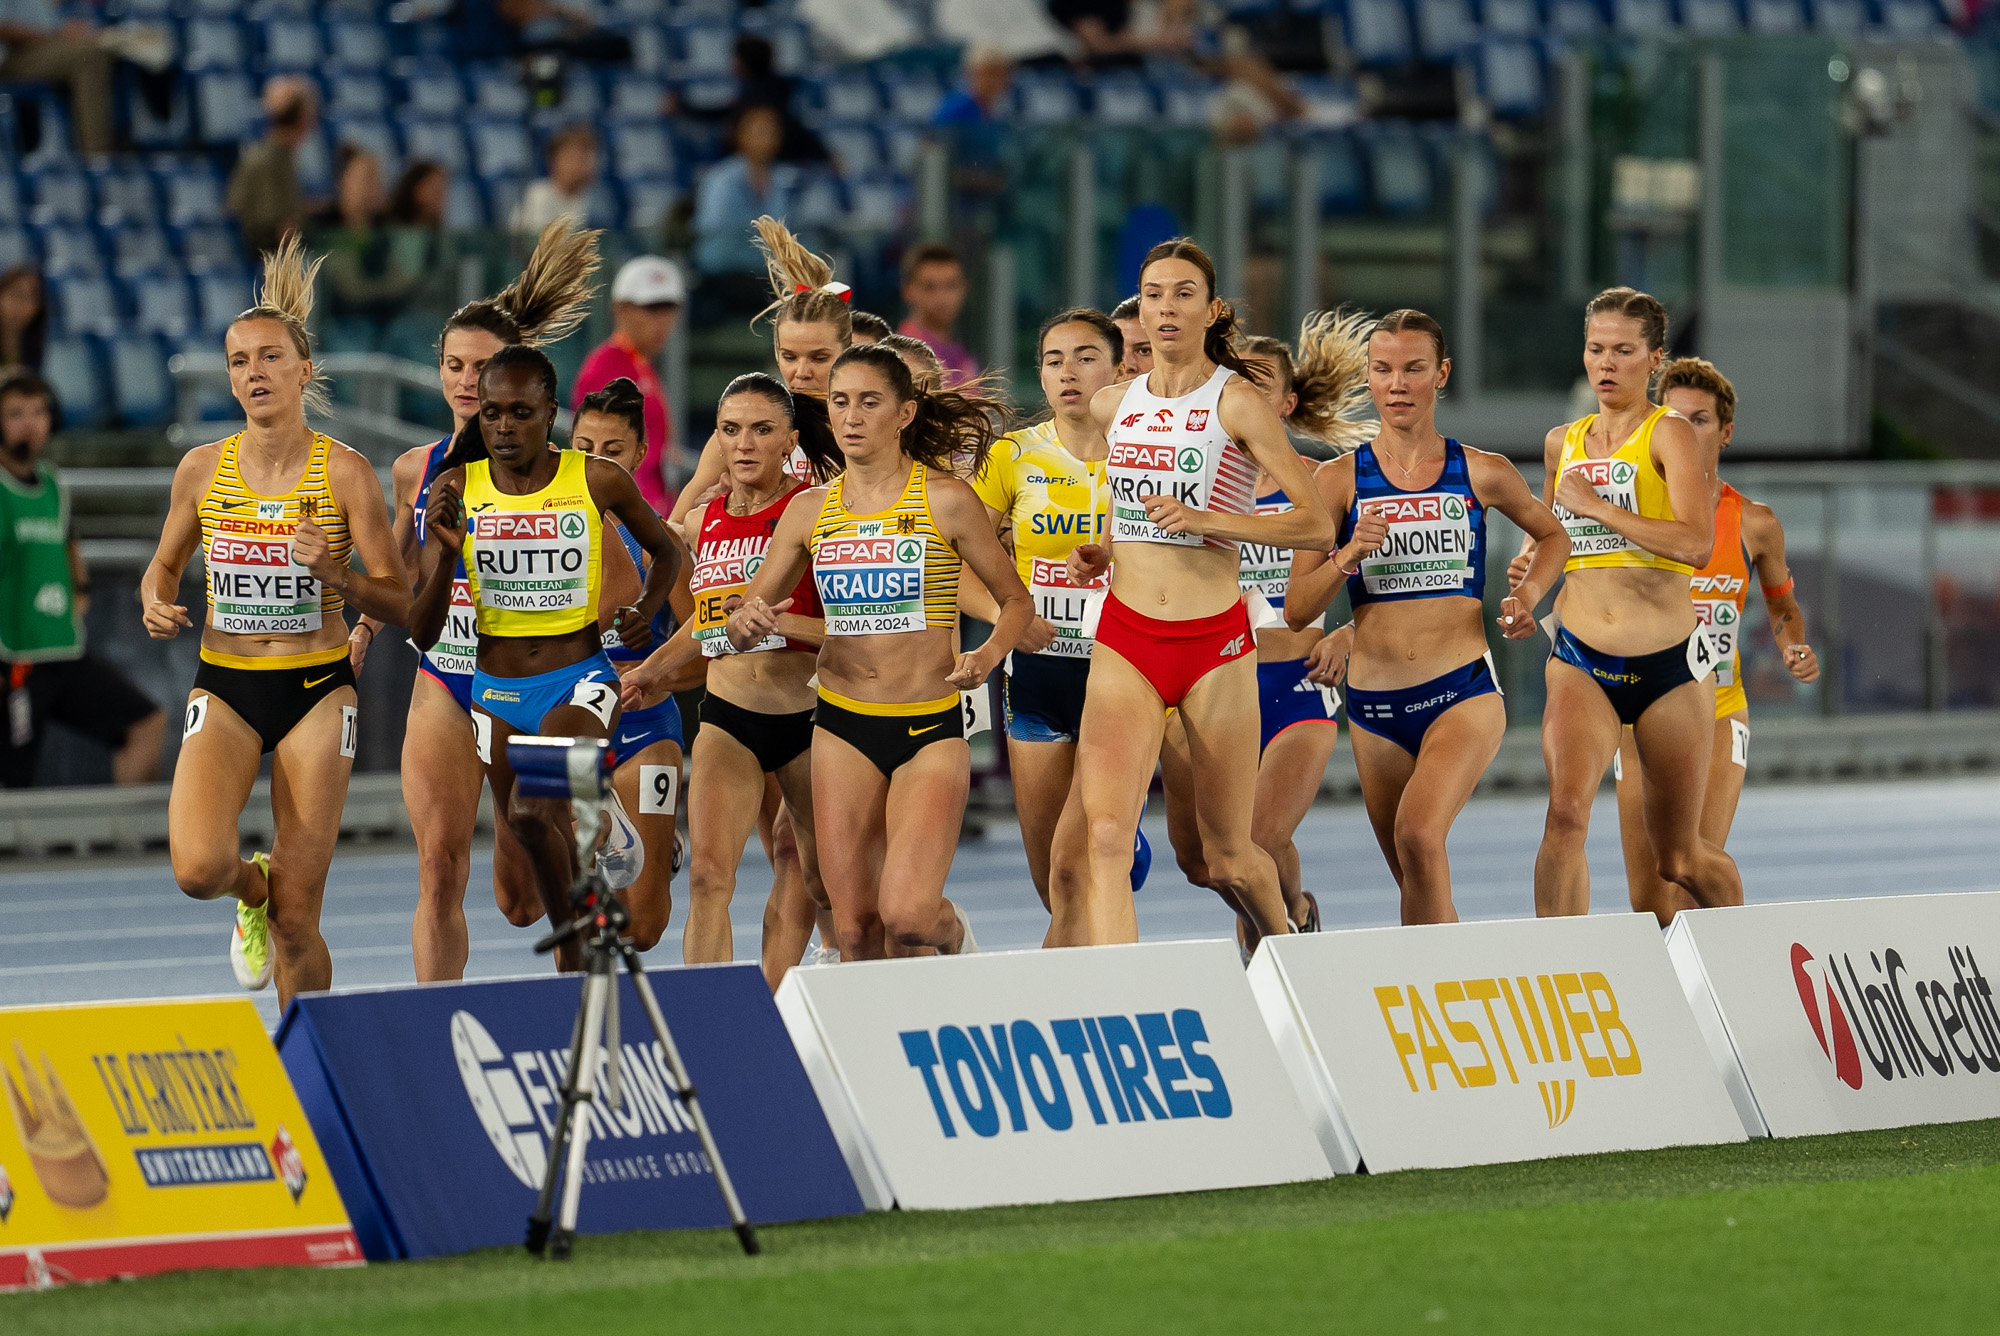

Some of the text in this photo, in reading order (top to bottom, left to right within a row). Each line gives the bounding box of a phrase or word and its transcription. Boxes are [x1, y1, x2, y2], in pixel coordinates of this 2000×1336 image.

[1120, 412, 1145, 428] 4F
[1146, 425, 1173, 433] ORLEN
[1110, 445, 1174, 468] SPAR
[1027, 475, 1067, 485] CRAFT
[1125, 510, 1143, 520] RUN
[477, 517, 556, 537] SPAR
[1118, 522, 1149, 538] ROMA
[818, 541, 893, 563] SPAR
[1595, 537, 1628, 551] 2024
[212, 541, 287, 564] SPAR
[475, 547, 583, 575] RUTTO
[1389, 563, 1412, 573] RUN
[690, 562, 744, 590] SPAR
[1254, 568, 1289, 580] CLEAN
[1379, 573, 1460, 591] ROMA 2024
[212, 570, 317, 600] MEYER
[503, 581, 526, 591] RUN
[817, 571, 920, 600] KRAUSE
[1266, 581, 1289, 595] 20
[493, 593, 573, 608] ROMA 2024
[230, 604, 295, 615] I RUN CLEAN
[840, 606, 861, 616] RUN
[223, 617, 308, 631] ROMA 2024
[833, 616, 911, 632] ROMA 2024
[706, 628, 723, 639] RUN
[1045, 640, 1084, 655] OMA
[1219, 632, 1245, 657] 4F
[1696, 634, 1711, 666] 4
[437, 656, 475, 672] ROMA
[1593, 667, 1630, 683] CRAFT
[586, 688, 606, 714] 2
[1404, 694, 1446, 713] CRAFT
[653, 772, 671, 808] 9
[1828, 944, 2000, 1082] UniCredit
[1373, 972, 1642, 1129] FASTWEB
[898, 1008, 1233, 1139] TOYO TIRES
